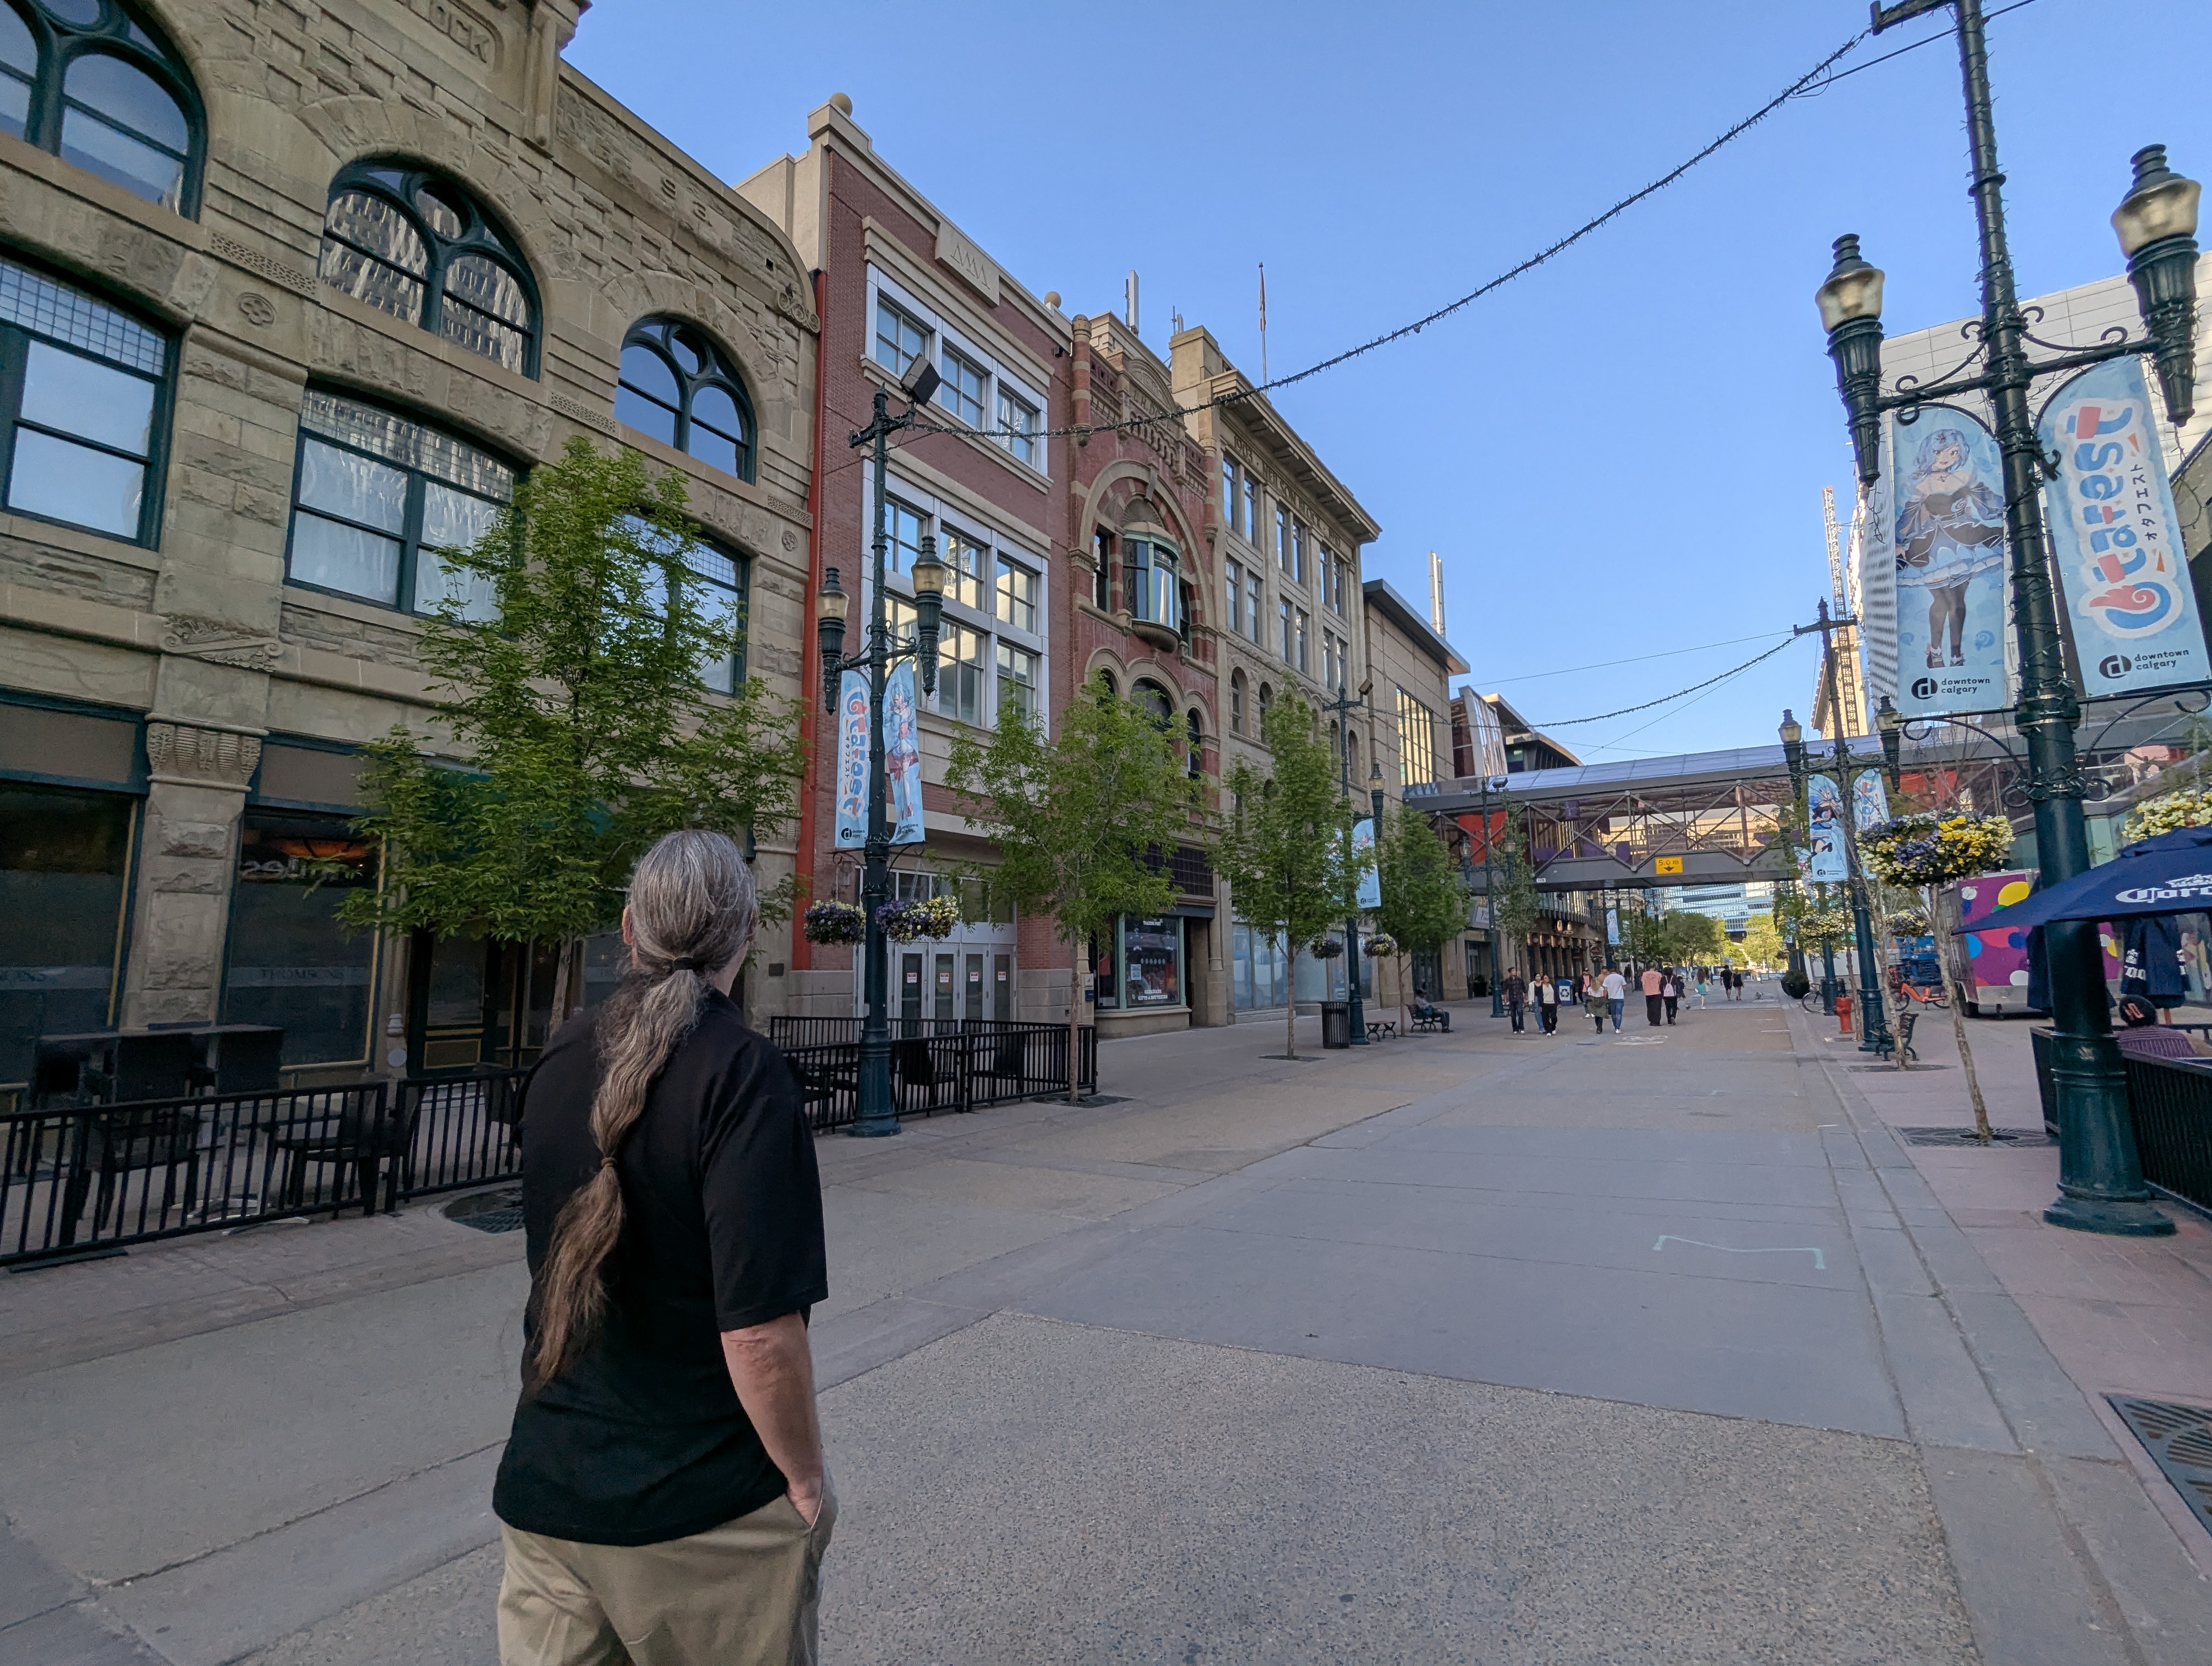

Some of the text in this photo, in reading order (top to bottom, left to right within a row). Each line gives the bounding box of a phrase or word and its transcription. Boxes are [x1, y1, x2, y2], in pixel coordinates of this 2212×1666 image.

[1233, 435, 1252, 462] 1903
[2134, 649, 2190, 662] downtown
[2136, 659, 2177, 670] calgary
[1940, 685, 1978, 695] calgary
